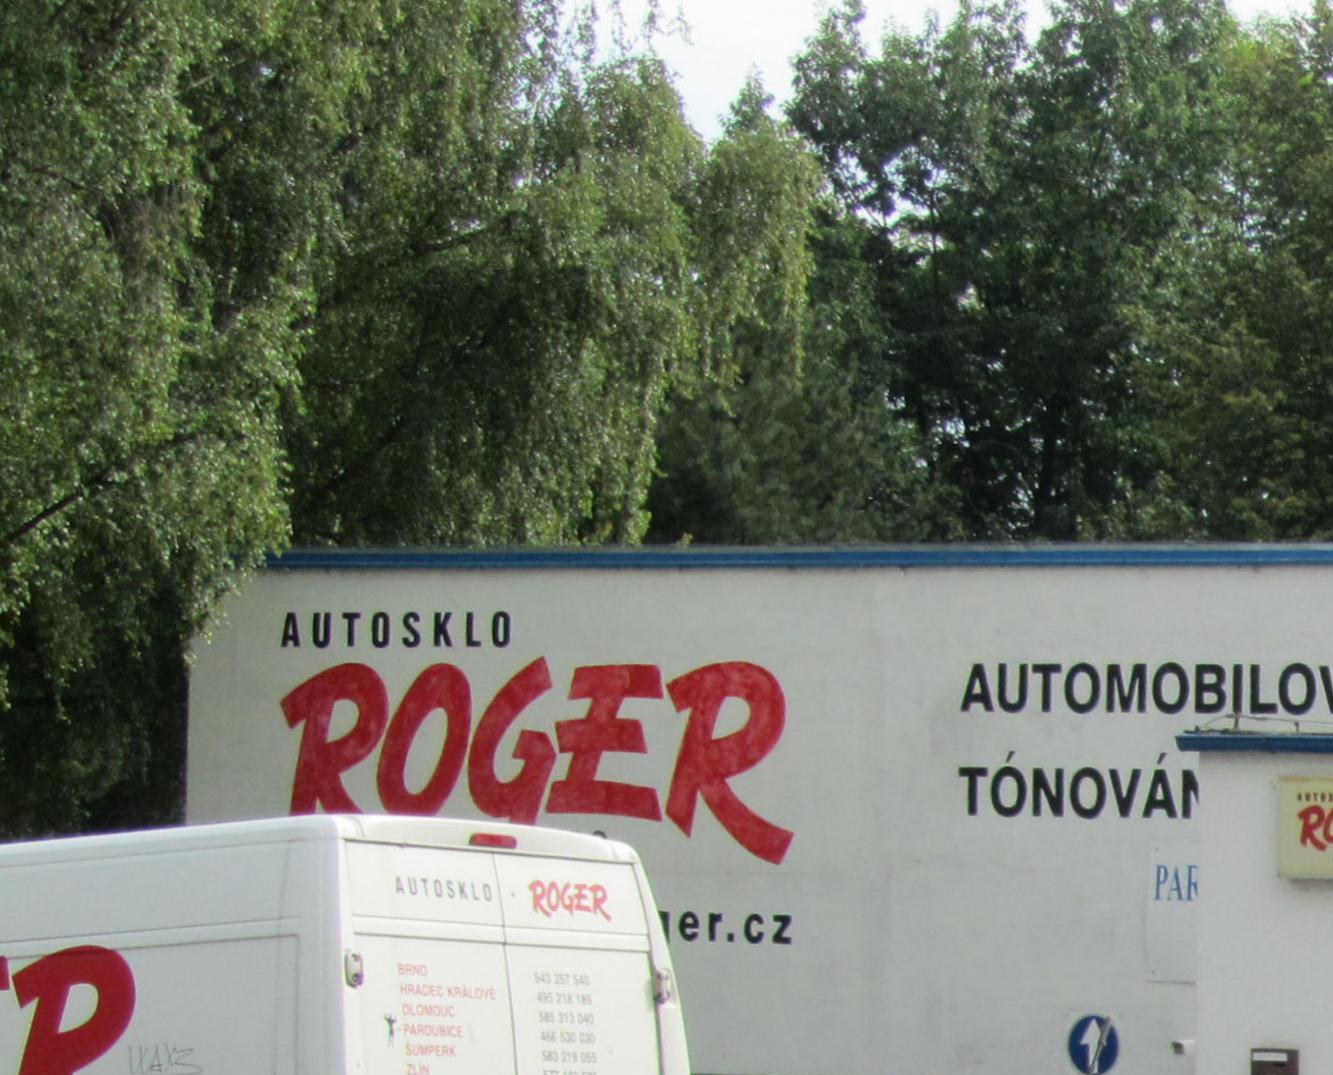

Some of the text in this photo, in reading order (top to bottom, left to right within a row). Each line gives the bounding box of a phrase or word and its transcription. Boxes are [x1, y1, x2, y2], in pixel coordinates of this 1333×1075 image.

[280, 611, 512, 648] AUTOSKLO
[280, 656, 794, 865] ROGER
[395, 876, 613, 922] AUTOSKLO ROGER
[397, 963, 428, 977] BRNO
[400, 984, 444, 998] HRADEC
[402, 1003, 455, 1018] OLOMOUC
[403, 1023, 464, 1038] PARDUBICE
[405, 1042, 457, 1057] ŠUMPERK
